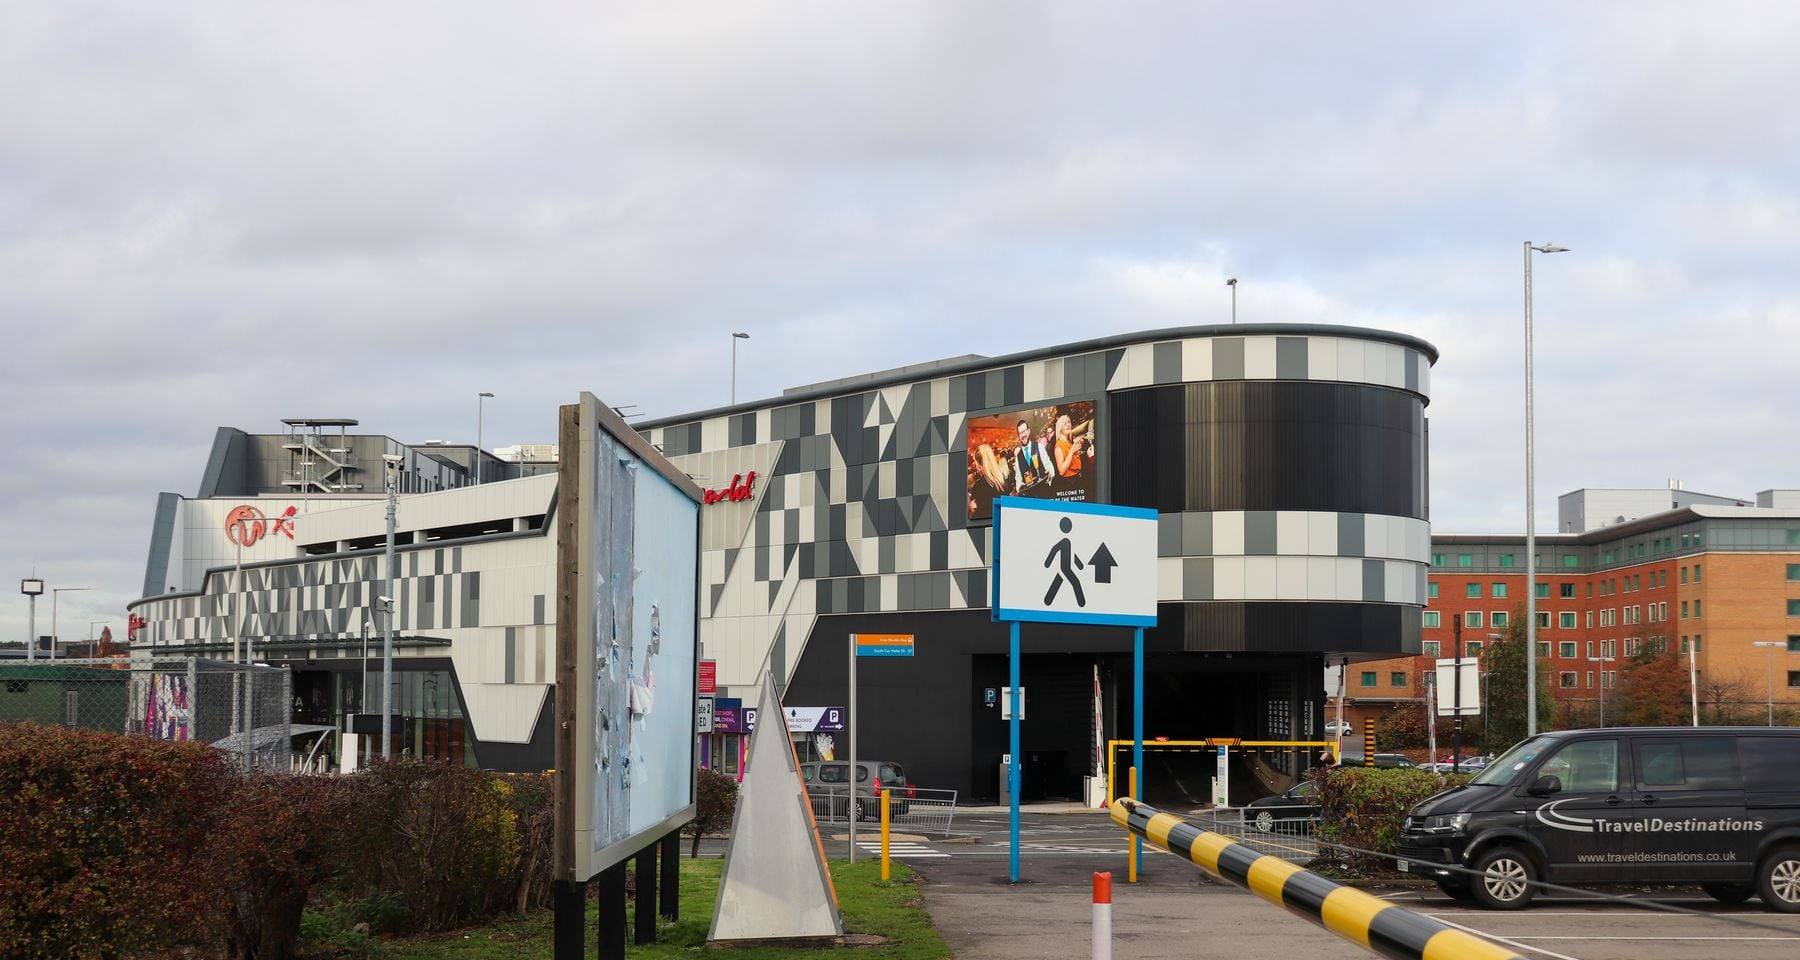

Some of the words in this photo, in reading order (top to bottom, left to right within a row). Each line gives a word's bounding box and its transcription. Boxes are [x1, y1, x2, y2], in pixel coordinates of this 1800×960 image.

[987, 690, 994, 701] P
[748, 712, 755, 722] P
[831, 712, 838, 721] P
[1577, 851, 1737, 863] www.traveldestinations.co.uk
